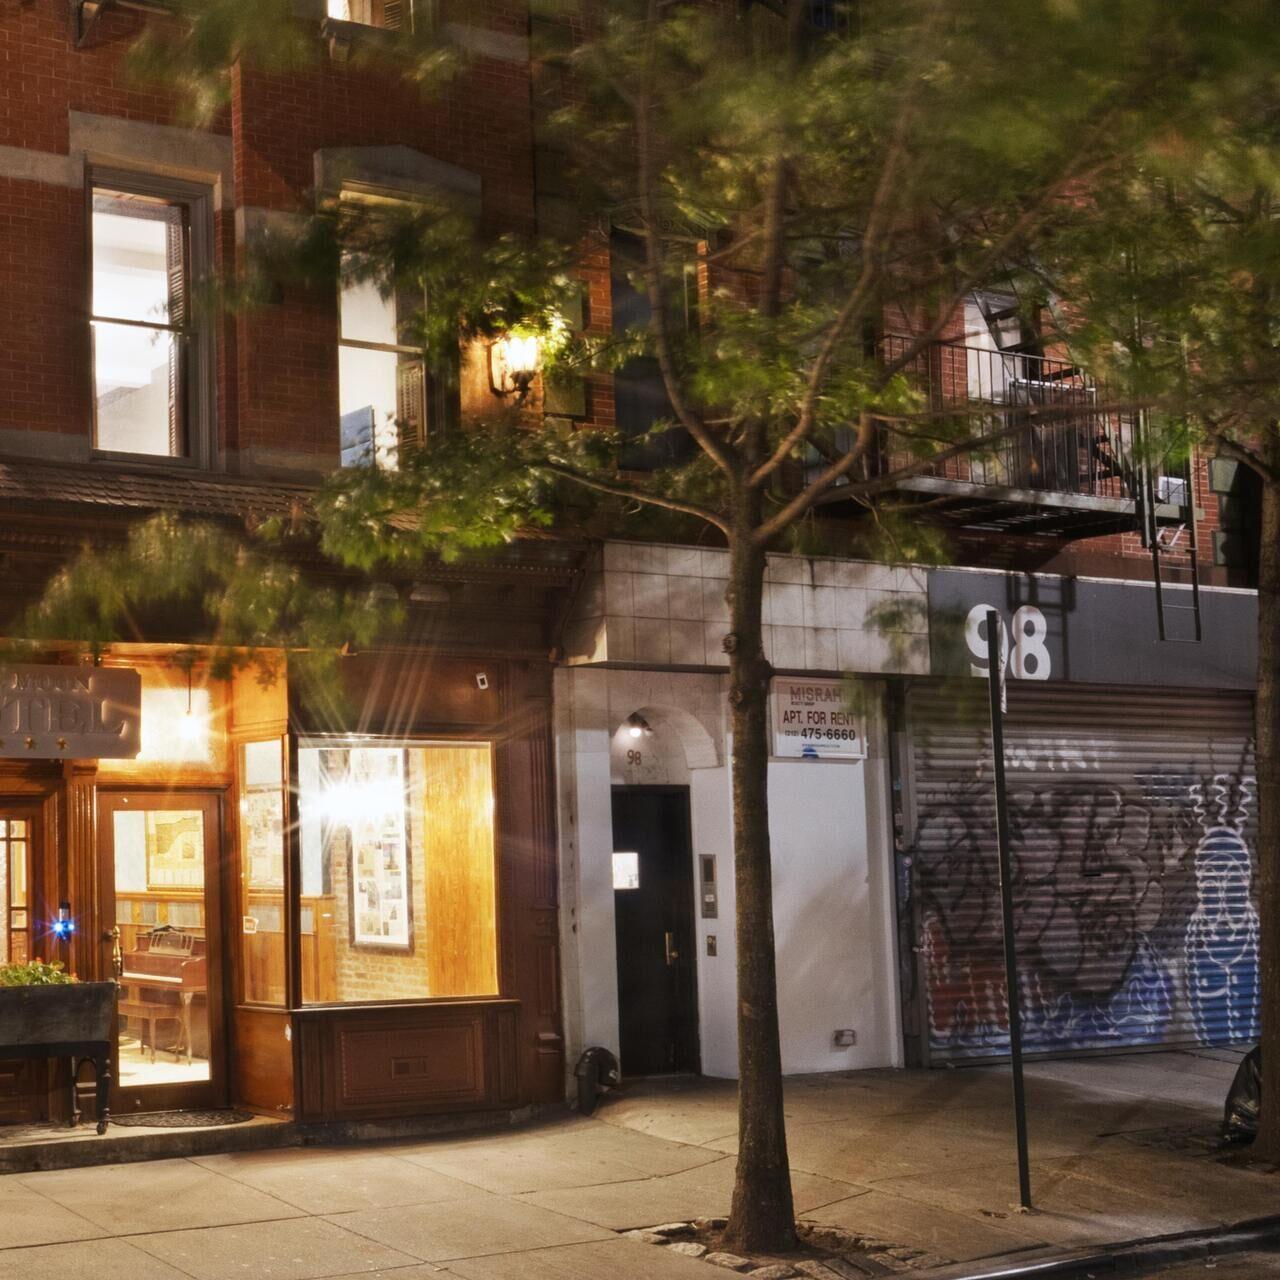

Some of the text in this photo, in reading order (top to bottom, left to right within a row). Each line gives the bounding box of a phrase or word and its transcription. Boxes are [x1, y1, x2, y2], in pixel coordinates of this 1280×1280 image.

[964, 604, 1052, 681] 98
[783, 710, 856, 726] APT. FOR RENT
[627, 748, 642, 766] 98
